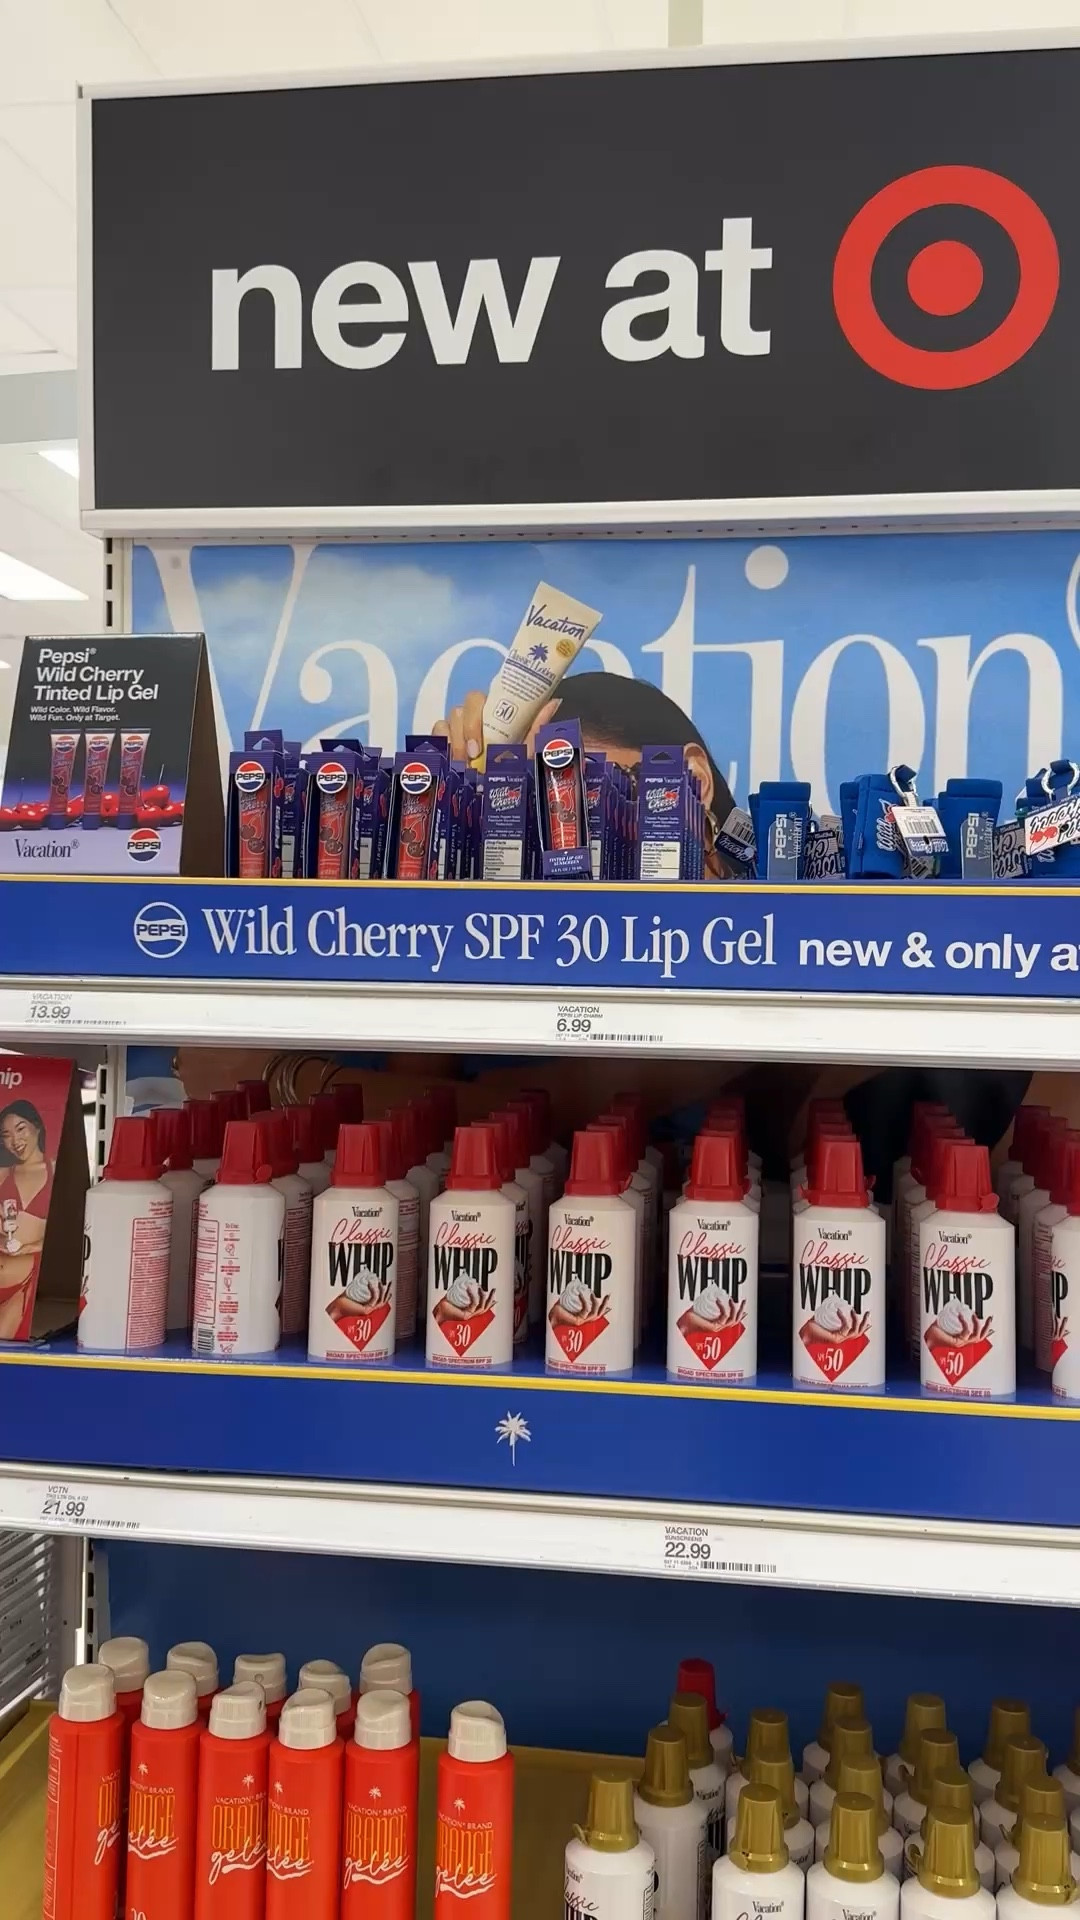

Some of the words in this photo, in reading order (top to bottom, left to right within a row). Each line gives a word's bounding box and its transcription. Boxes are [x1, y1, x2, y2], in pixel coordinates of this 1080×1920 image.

[211, 256, 560, 371] new
[600, 217, 773, 359] at
[526, 603, 588, 641] Vacation
[36, 666, 76, 683] Wild
[79, 666, 144, 685] Cherry
[33, 685, 92, 701] Tinted
[95, 685, 123, 703] Lip
[127, 684, 159, 701] Gel
[29, 713, 48, 722] Wild
[48, 714, 64, 722] Fun.
[66, 714, 83, 723] Only
[95, 714, 121, 722] Target.
[49, 706, 72, 714] Color.
[495, 702, 515, 722] 50
[543, 748, 573, 759] PEPSI
[236, 772, 264, 781] PEPSI
[317, 773, 346, 782] PEPSI
[401, 774, 431, 782] PEPSI
[127, 841, 162, 851] PEPSI
[775, 813, 788, 859] PEPSI
[965, 812, 980, 859] PEPSI
[136, 922, 187, 937] PEPSI
[201, 904, 298, 957] Wild
[307, 905, 454, 973] Cherry
[463, 911, 545, 961] SPF
[555, 913, 610, 968] 30
[620, 914, 691, 979] Lip
[702, 912, 778, 967] Gel
[799, 938, 893, 968] new
[901, 930, 937, 970] &
[945, 932, 1043, 980] only
[30, 1005, 71, 1019] 13.99
[558, 1005, 600, 1013] VACATION
[556, 1018, 592, 1033] 6.99
[331, 1217, 393, 1247] Classic
[435, 1221, 497, 1250] Classic
[551, 1225, 612, 1254] Classic
[679, 1230, 746, 1261] Classic
[800, 1239, 872, 1271] Classic
[328, 1241, 394, 1288] WHIP
[433, 1244, 499, 1292] WHIP
[924, 1242, 992, 1275] Classic
[550, 1247, 613, 1298] WHIP
[676, 1253, 748, 1303] WHIP
[799, 1263, 872, 1315] WHIP
[923, 1266, 994, 1320] WHIP
[354, 1318, 372, 1342] 30
[454, 1324, 471, 1347] 30
[566, 1329, 583, 1353] 30
[702, 1336, 722, 1361] 50
[823, 1348, 844, 1373] 50
[945, 1351, 964, 1377] 50
[48, 1485, 69, 1494] VCTN
[41, 1500, 86, 1517] 21.99
[664, 1526, 709, 1537] VACATION
[664, 1541, 711, 1560] 22.99
[149, 1787, 175, 1795] BRAND
[284, 1806, 309, 1816] BRAND
[382, 1805, 407, 1817] BRAND
[346, 1810, 408, 1863] ORANGE
[467, 1821, 493, 1830] BRAND
